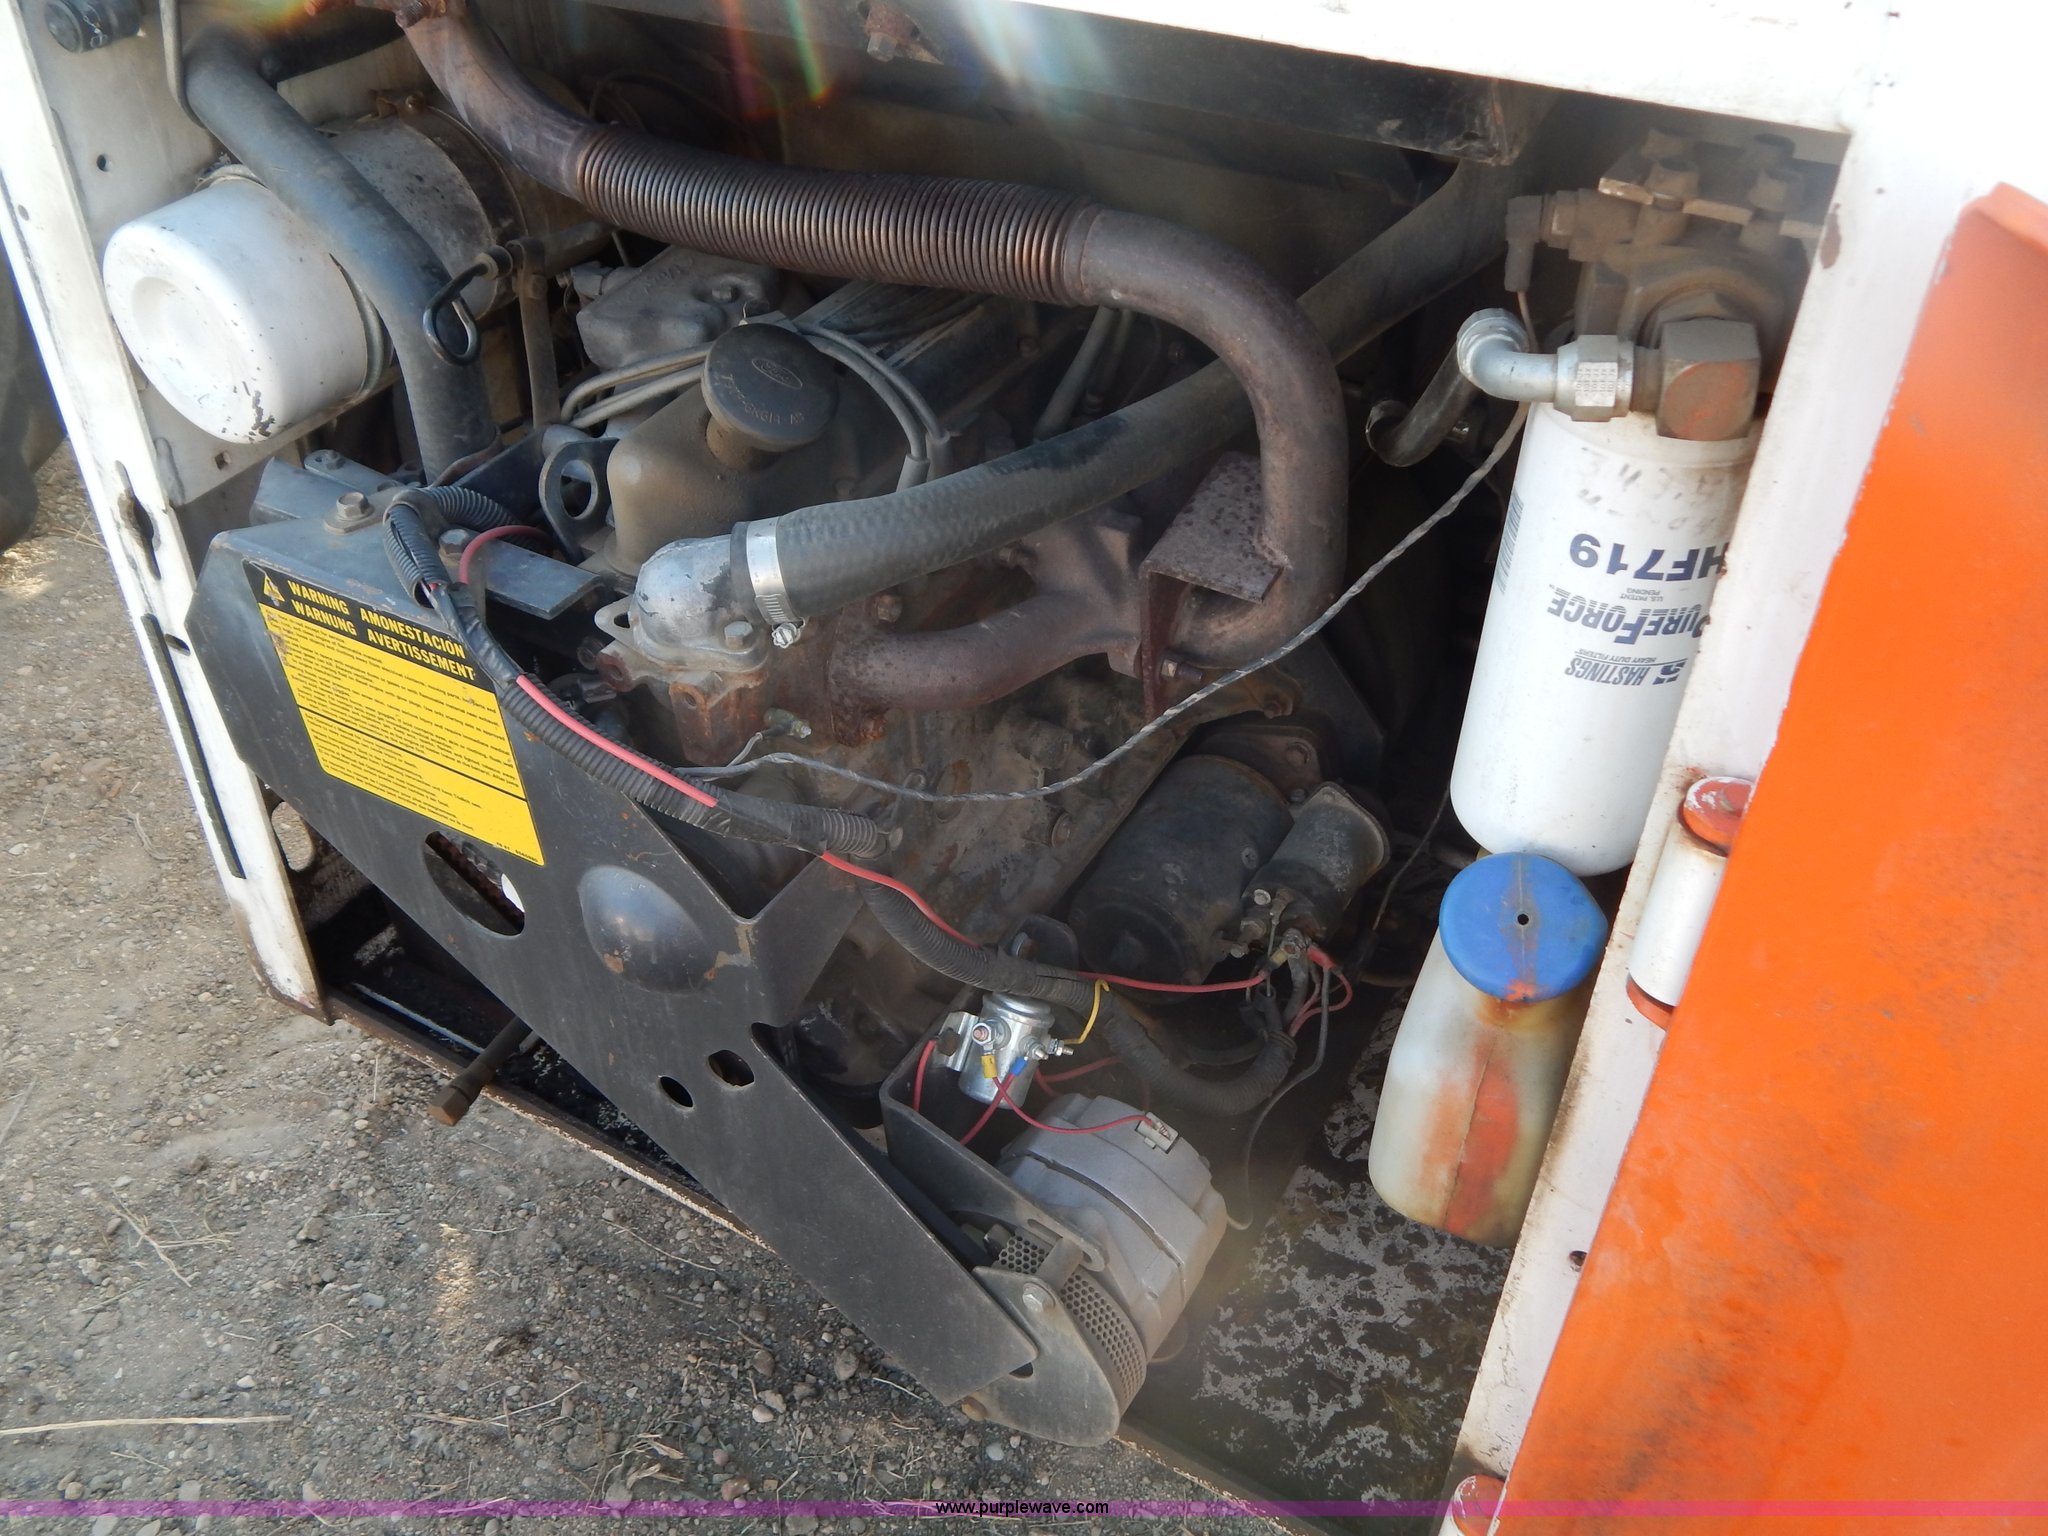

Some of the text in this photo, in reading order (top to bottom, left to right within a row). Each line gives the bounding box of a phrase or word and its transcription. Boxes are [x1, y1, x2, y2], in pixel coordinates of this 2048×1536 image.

[1569, 533, 1730, 581] HF719
[287, 580, 350, 616] WARNING
[291, 599, 475, 681] WARNUNG AVERTISSEMENT
[1564, 657, 1652, 686] HASTINGS
[1610, 655, 1632, 663] DUTY
[1632, 656, 1657, 664] HEAVY
